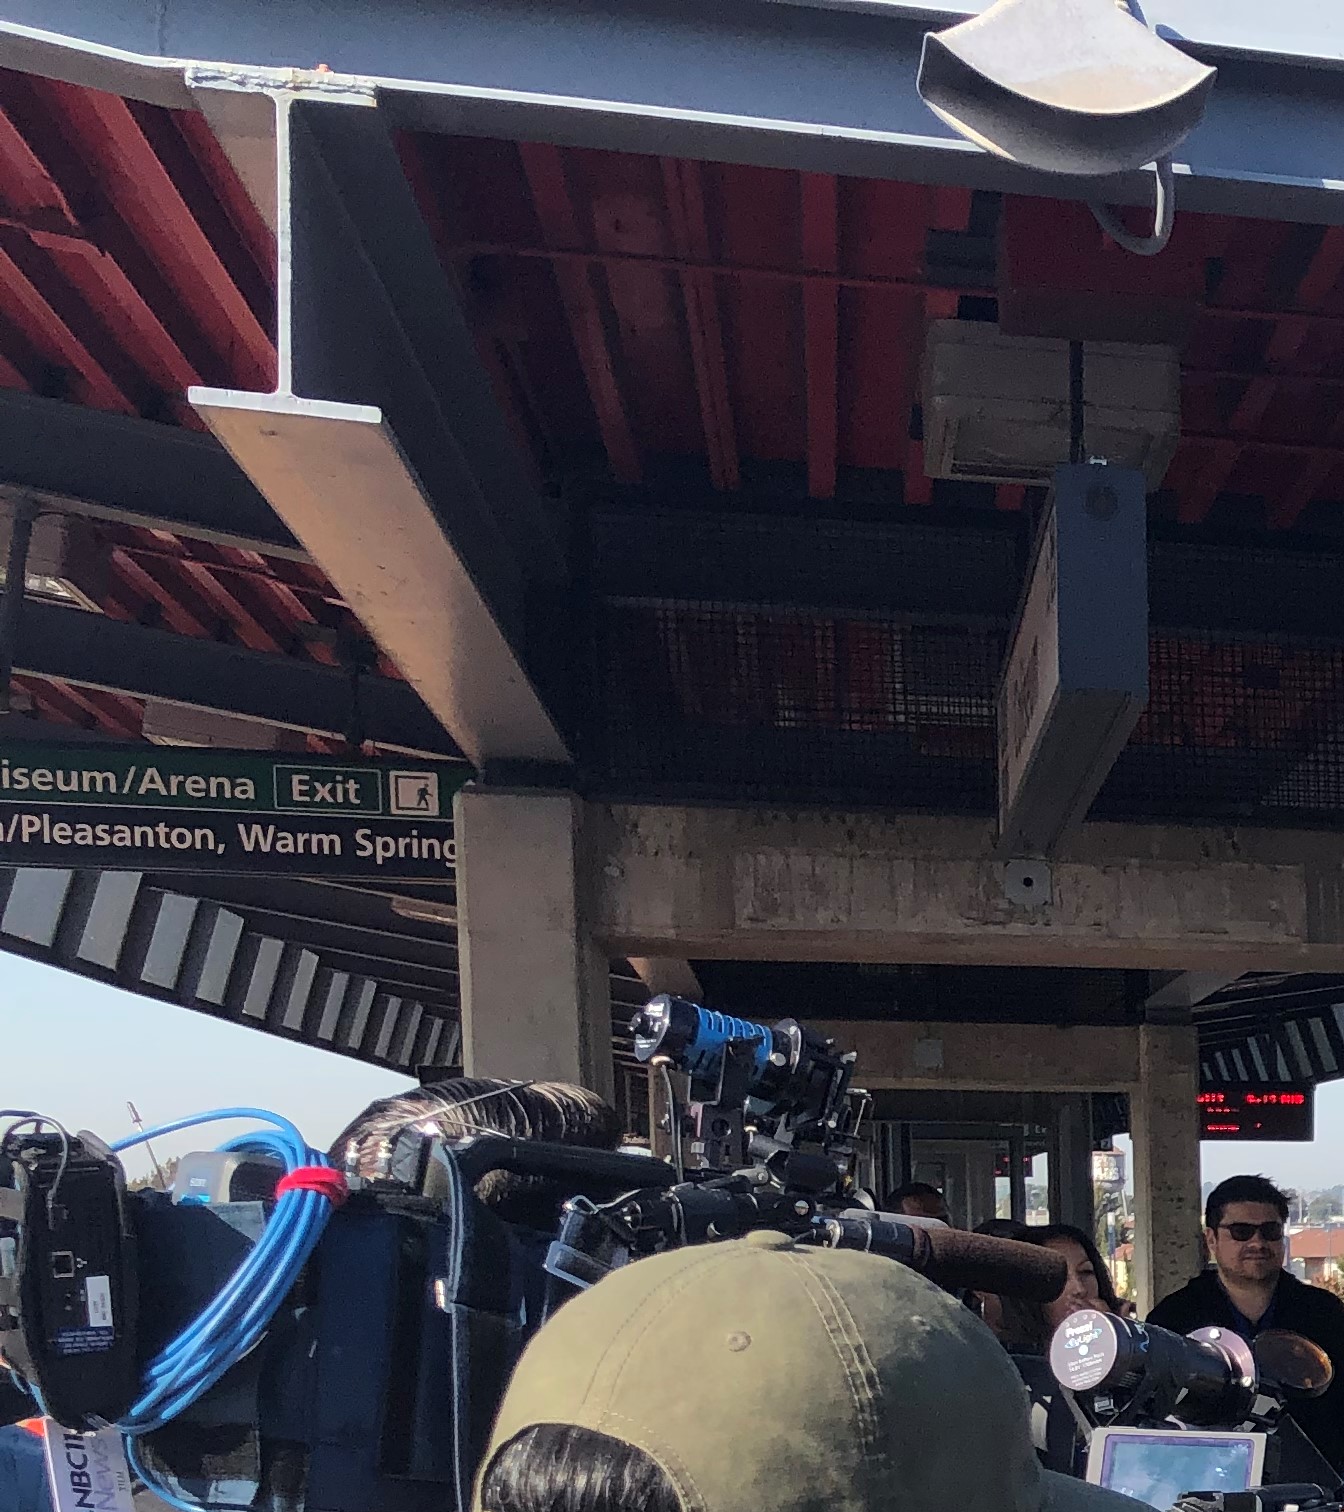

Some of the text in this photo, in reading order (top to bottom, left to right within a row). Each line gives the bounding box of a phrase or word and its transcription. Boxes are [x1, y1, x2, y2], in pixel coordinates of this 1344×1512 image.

[1, 760, 361, 804] iseum/Arena Exit
[237, 823, 342, 856] Warm
[355, 829, 456, 867] Spring
[63, 1433, 95, 1509] NBC11
[91, 1438, 119, 1512] News
